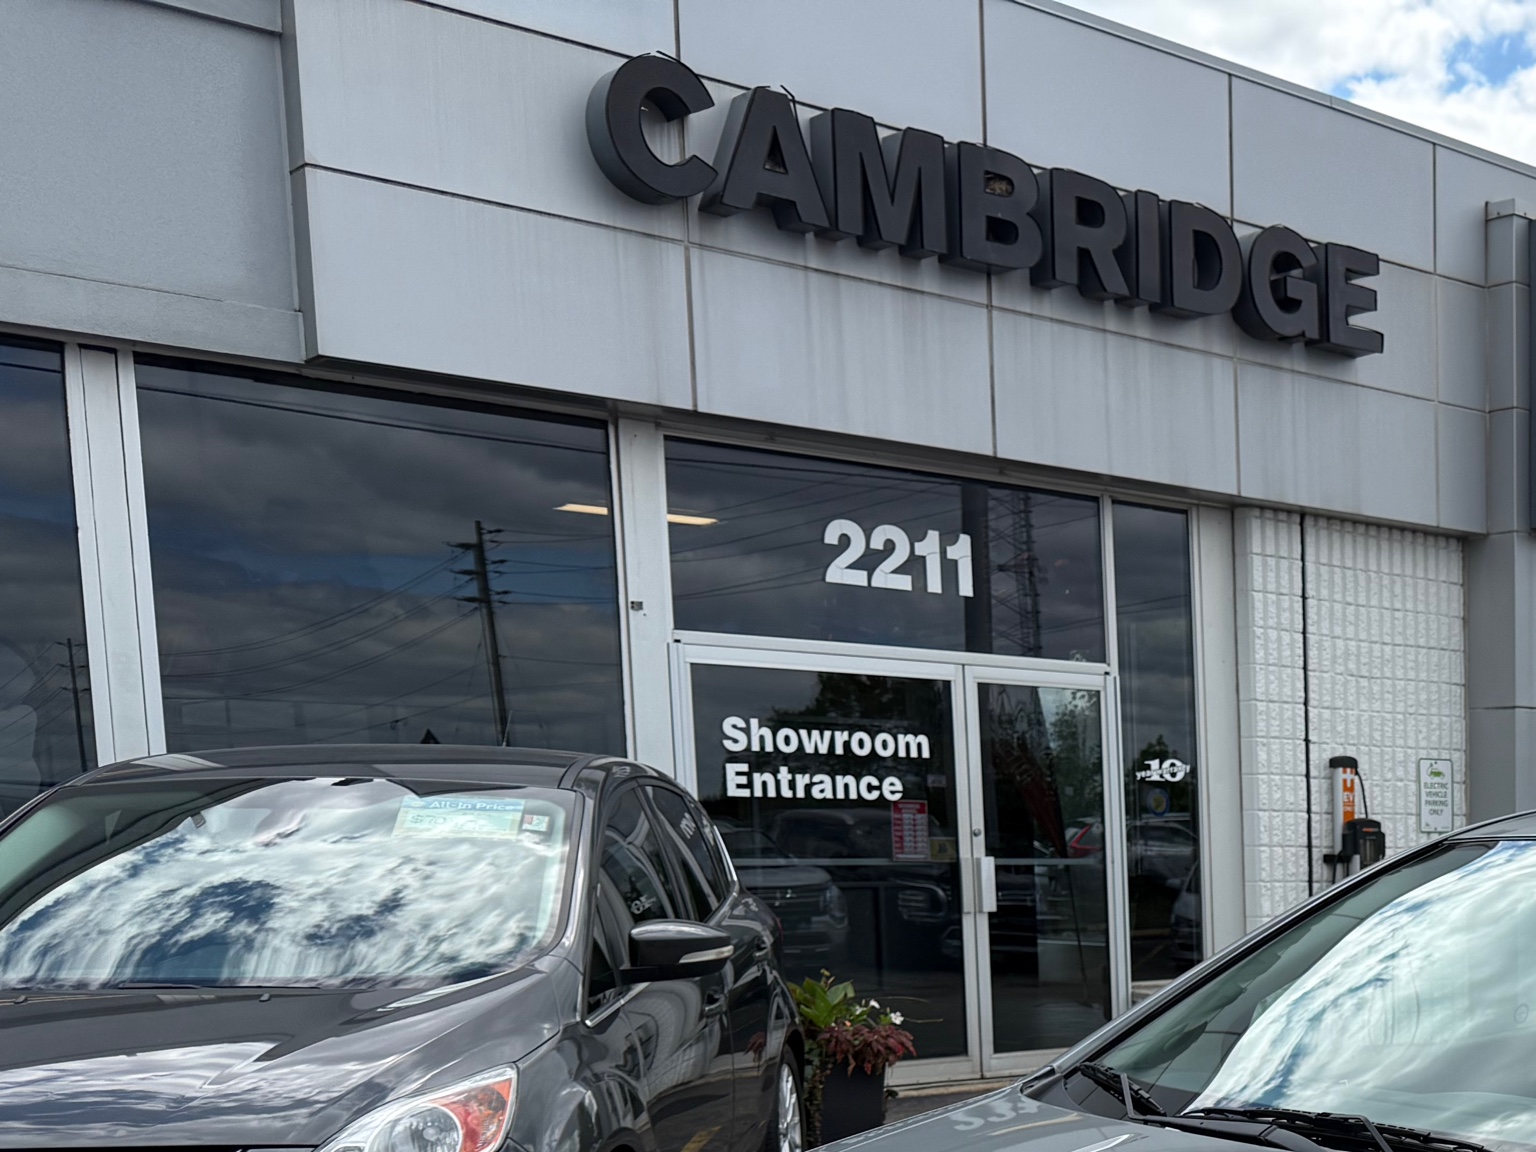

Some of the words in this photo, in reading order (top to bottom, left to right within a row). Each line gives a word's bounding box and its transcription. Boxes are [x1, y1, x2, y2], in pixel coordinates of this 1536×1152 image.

[585, 53, 1384, 357] CAMBRIDGE
[823, 519, 974, 598] 2211
[722, 716, 930, 759] Showroom
[725, 763, 904, 801] Entrance
[1143, 758, 1186, 782] 10
[1423, 782, 1449, 790] ELECTRIC
[429, 801, 471, 810] All-In
[1428, 808, 1444, 816] ONLY
